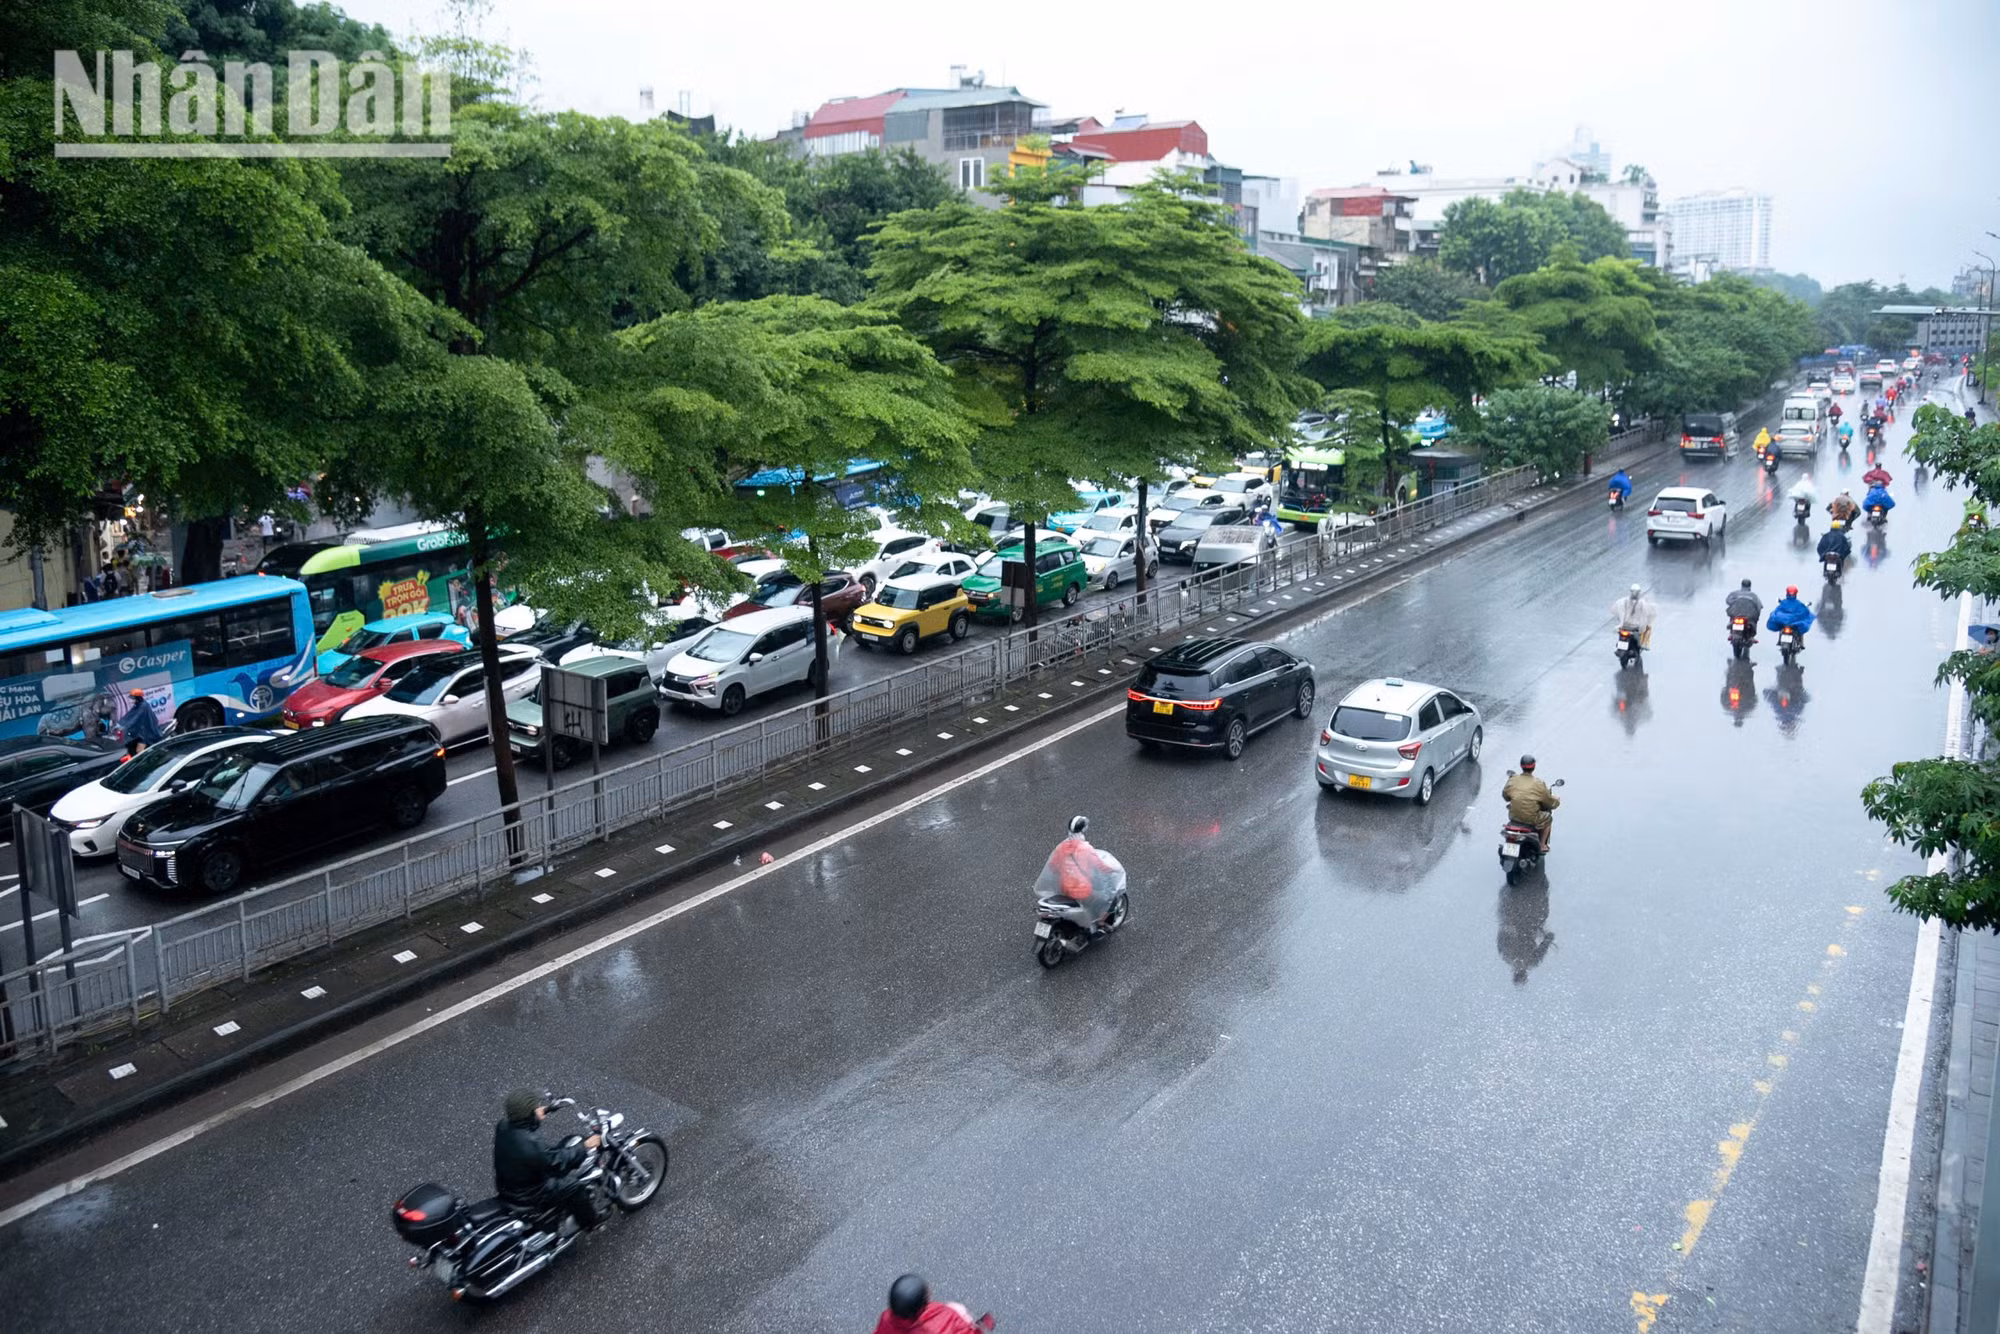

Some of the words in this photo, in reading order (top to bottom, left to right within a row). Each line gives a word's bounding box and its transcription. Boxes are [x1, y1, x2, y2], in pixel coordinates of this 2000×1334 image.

[137, 650, 186, 669] Casper
[15, 693, 40, 705] HÒA
[19, 705, 41, 717] LAN
